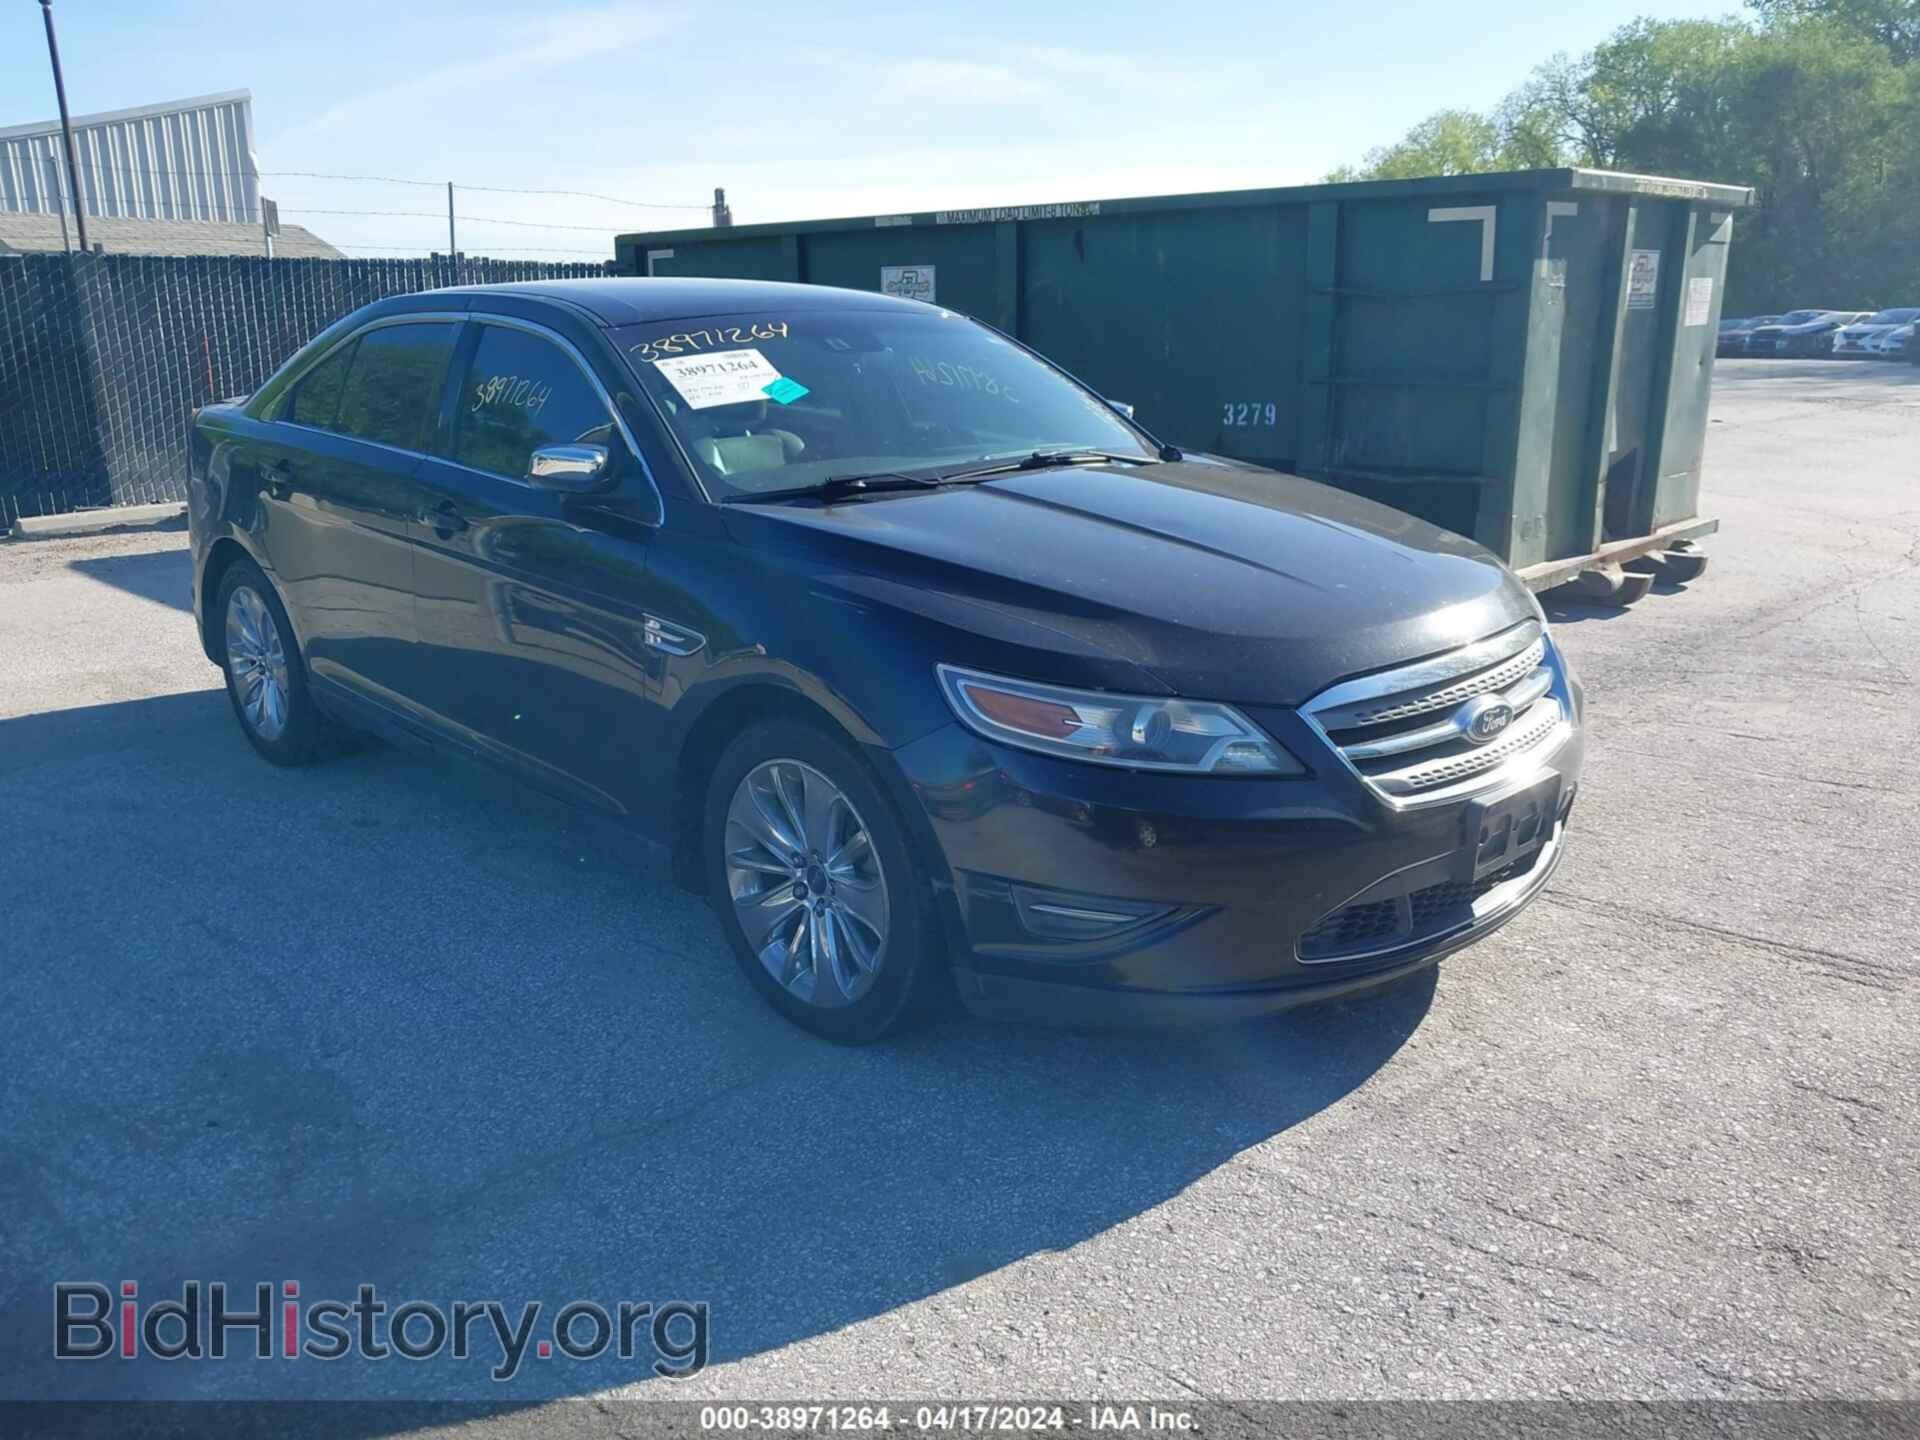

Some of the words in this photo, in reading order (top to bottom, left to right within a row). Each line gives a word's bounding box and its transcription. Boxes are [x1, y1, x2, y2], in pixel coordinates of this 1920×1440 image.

[630, 322, 788, 362] 38971264
[674, 360, 759, 378] 38971264
[471, 375, 553, 416] 38971264
[1223, 402, 1277, 426] 3279
[1482, 708, 1507, 733] Ford
